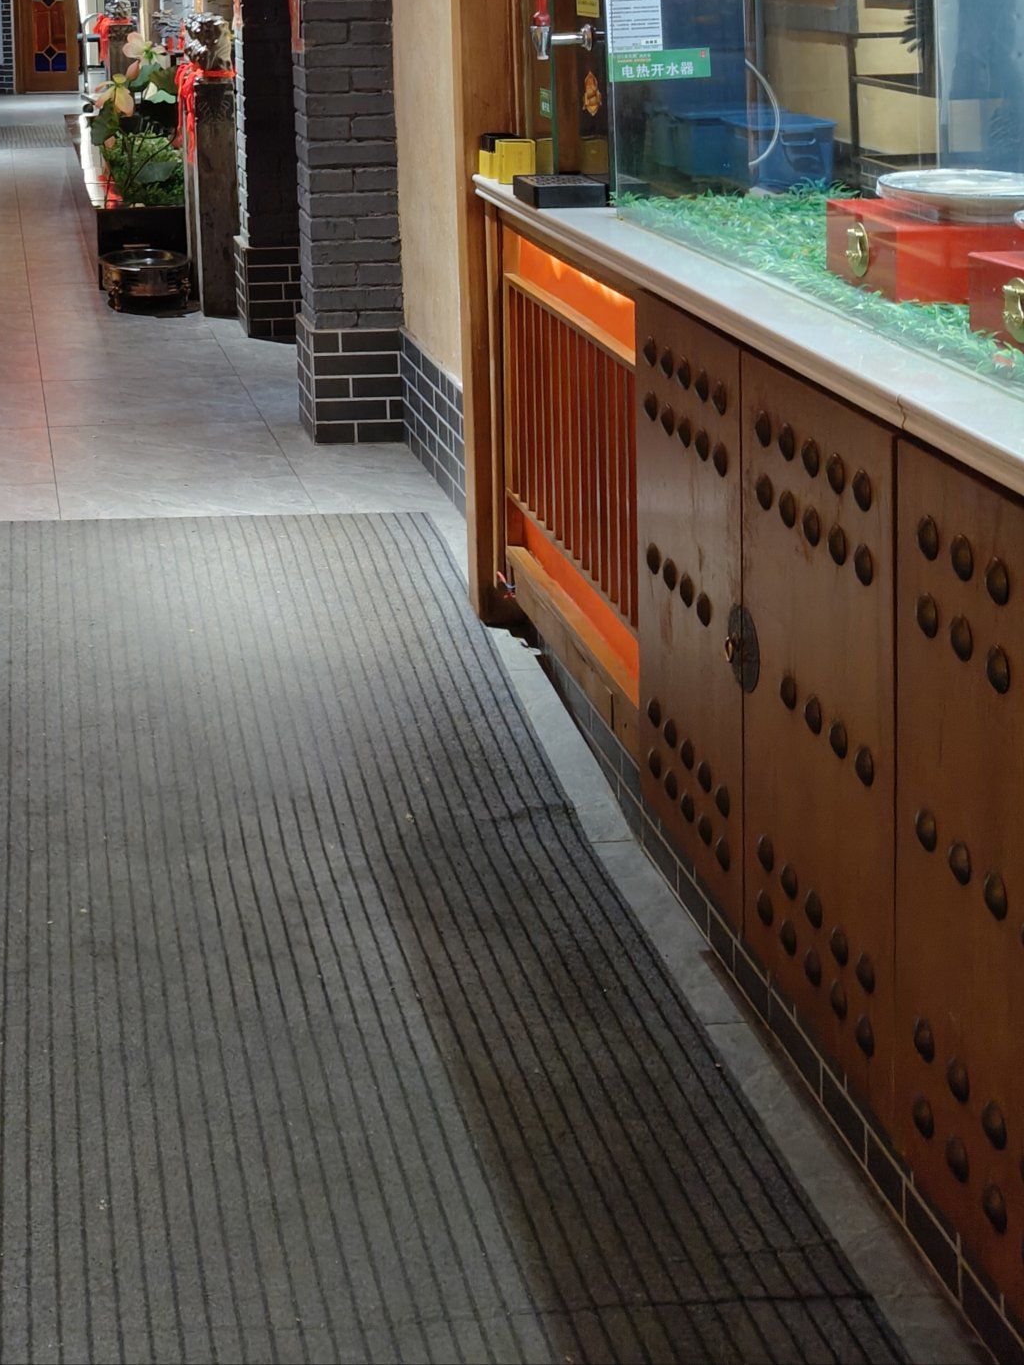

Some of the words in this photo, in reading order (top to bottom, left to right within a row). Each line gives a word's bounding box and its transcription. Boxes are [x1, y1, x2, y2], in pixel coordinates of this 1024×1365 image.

[621, 61, 695, 79] 电热开水器
